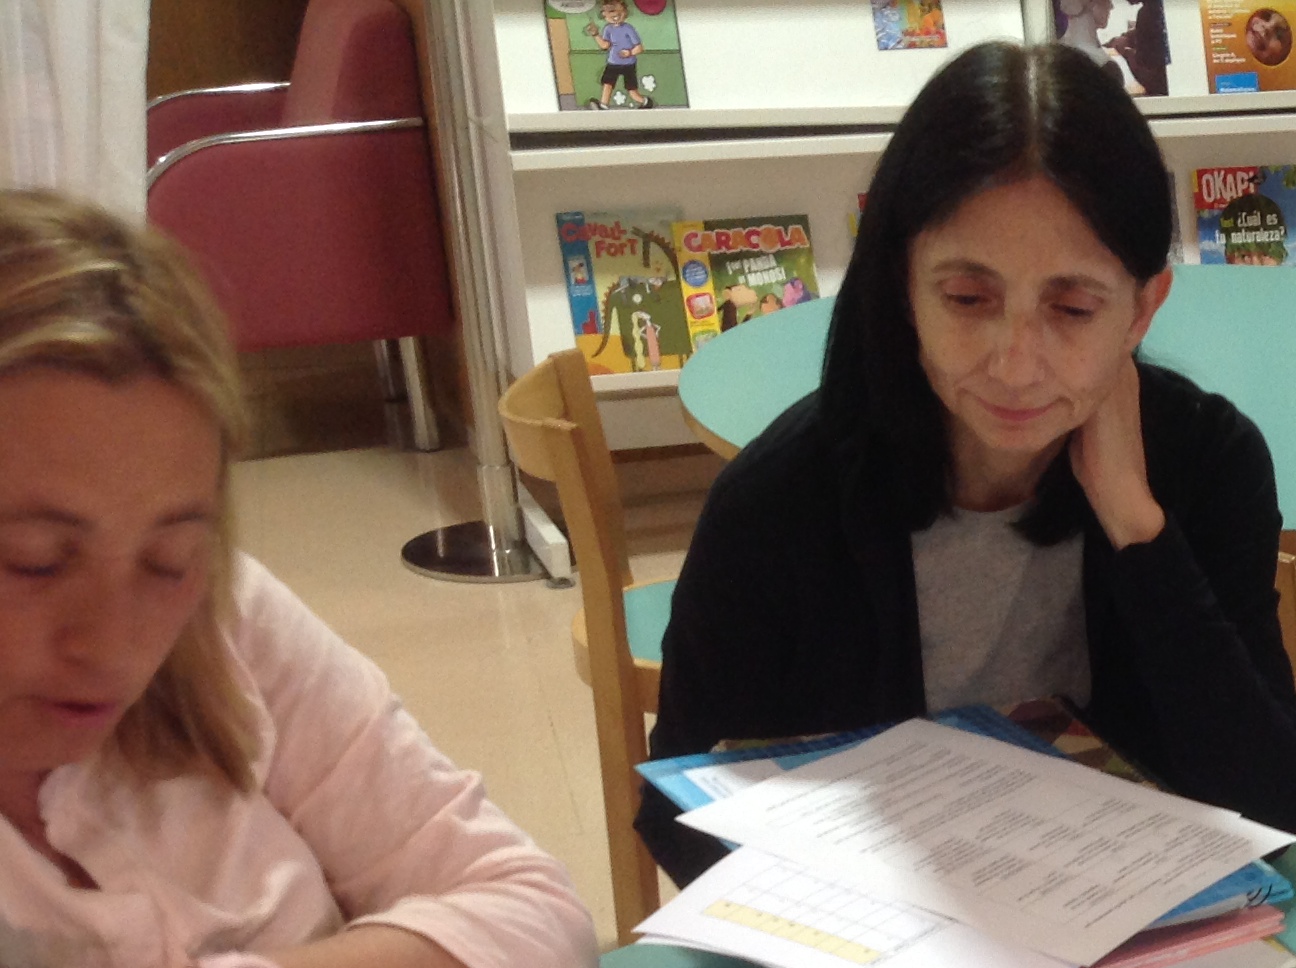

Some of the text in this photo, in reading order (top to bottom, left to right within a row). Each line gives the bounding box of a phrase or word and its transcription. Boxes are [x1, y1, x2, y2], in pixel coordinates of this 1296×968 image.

[1266, 213, 1278, 224] es
[683, 225, 809, 254] CARACOLA
[1215, 228, 1285, 244] tu naturaleza?
